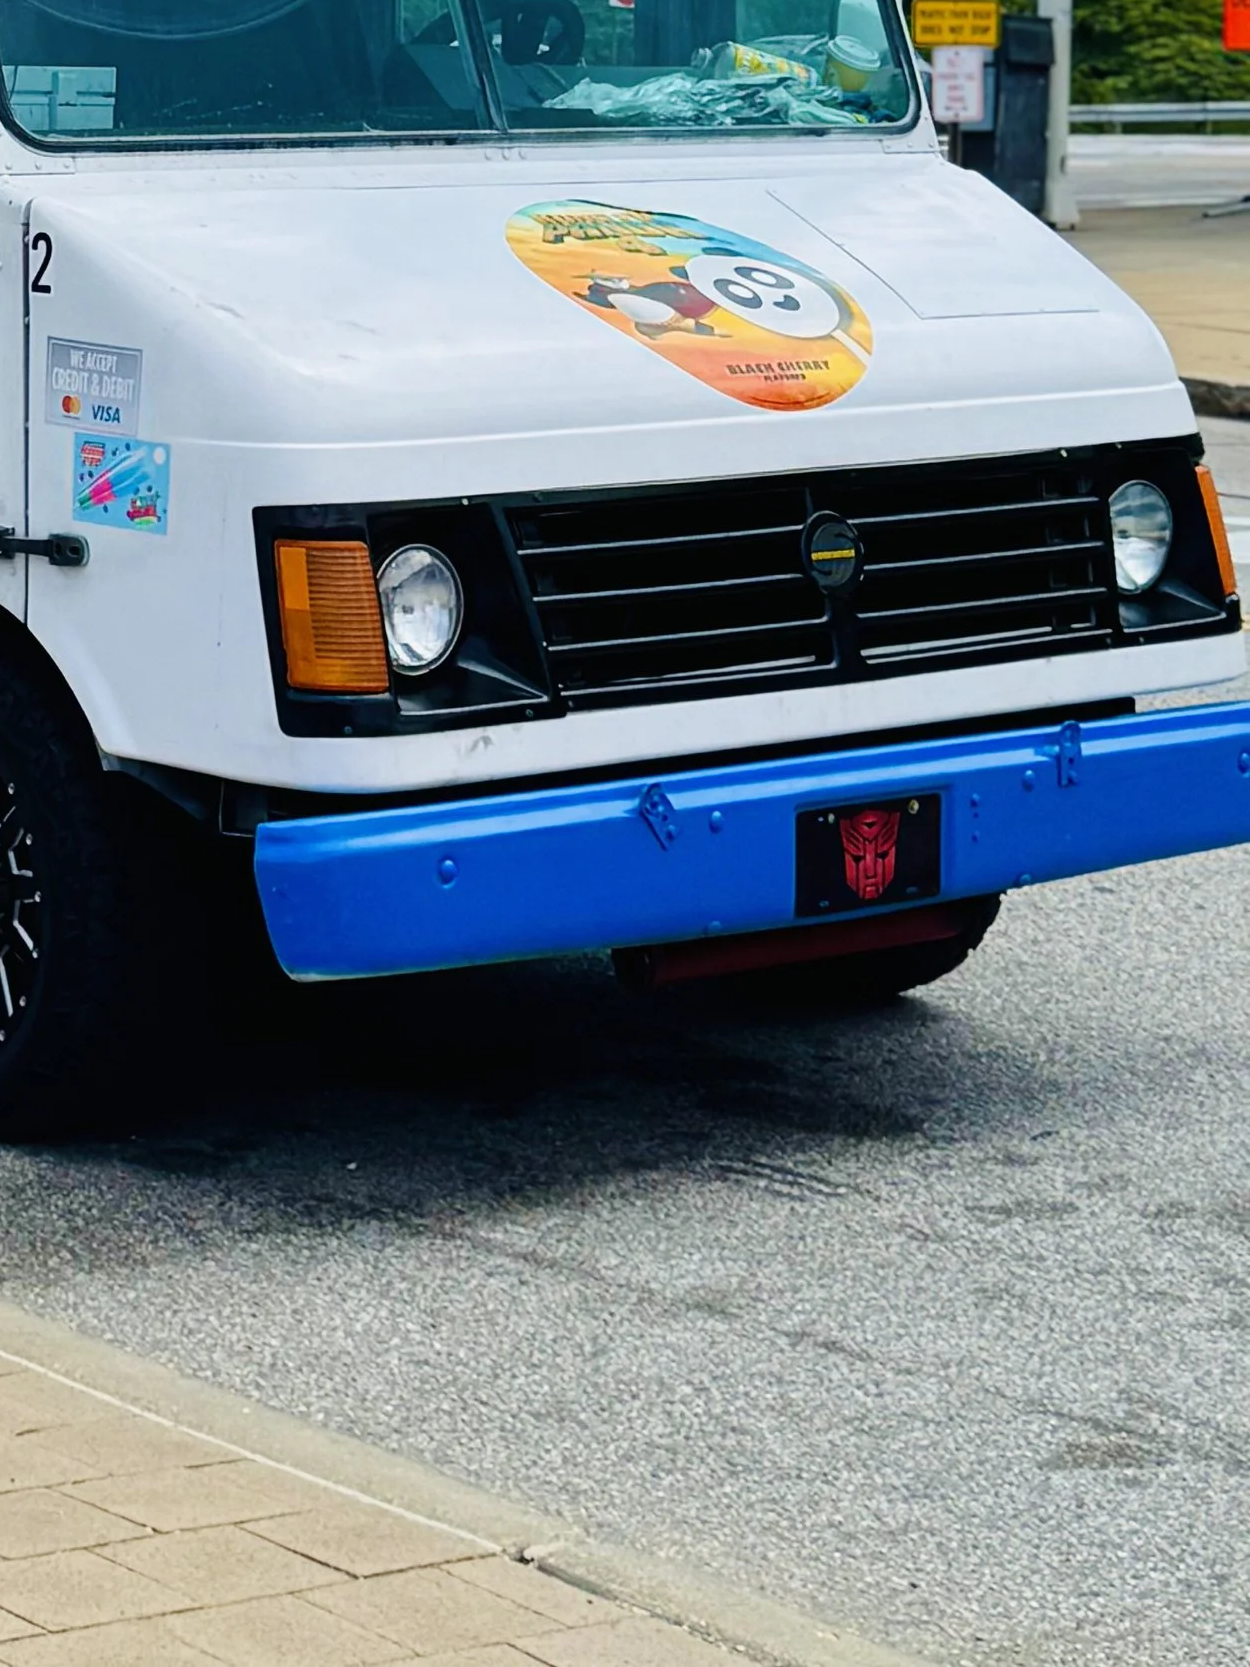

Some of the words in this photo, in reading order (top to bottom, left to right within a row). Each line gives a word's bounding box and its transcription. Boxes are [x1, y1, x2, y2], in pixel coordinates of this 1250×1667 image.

[31, 232, 53, 295] 2
[70, 348, 85, 369] WE
[85, 352, 118, 374] ACCEPT
[725, 363, 775, 375] BLACK
[52, 366, 90, 394] CREDIT
[91, 373, 100, 396] &
[101, 375, 134, 402] DEBIT
[91, 403, 121, 424] VISA
